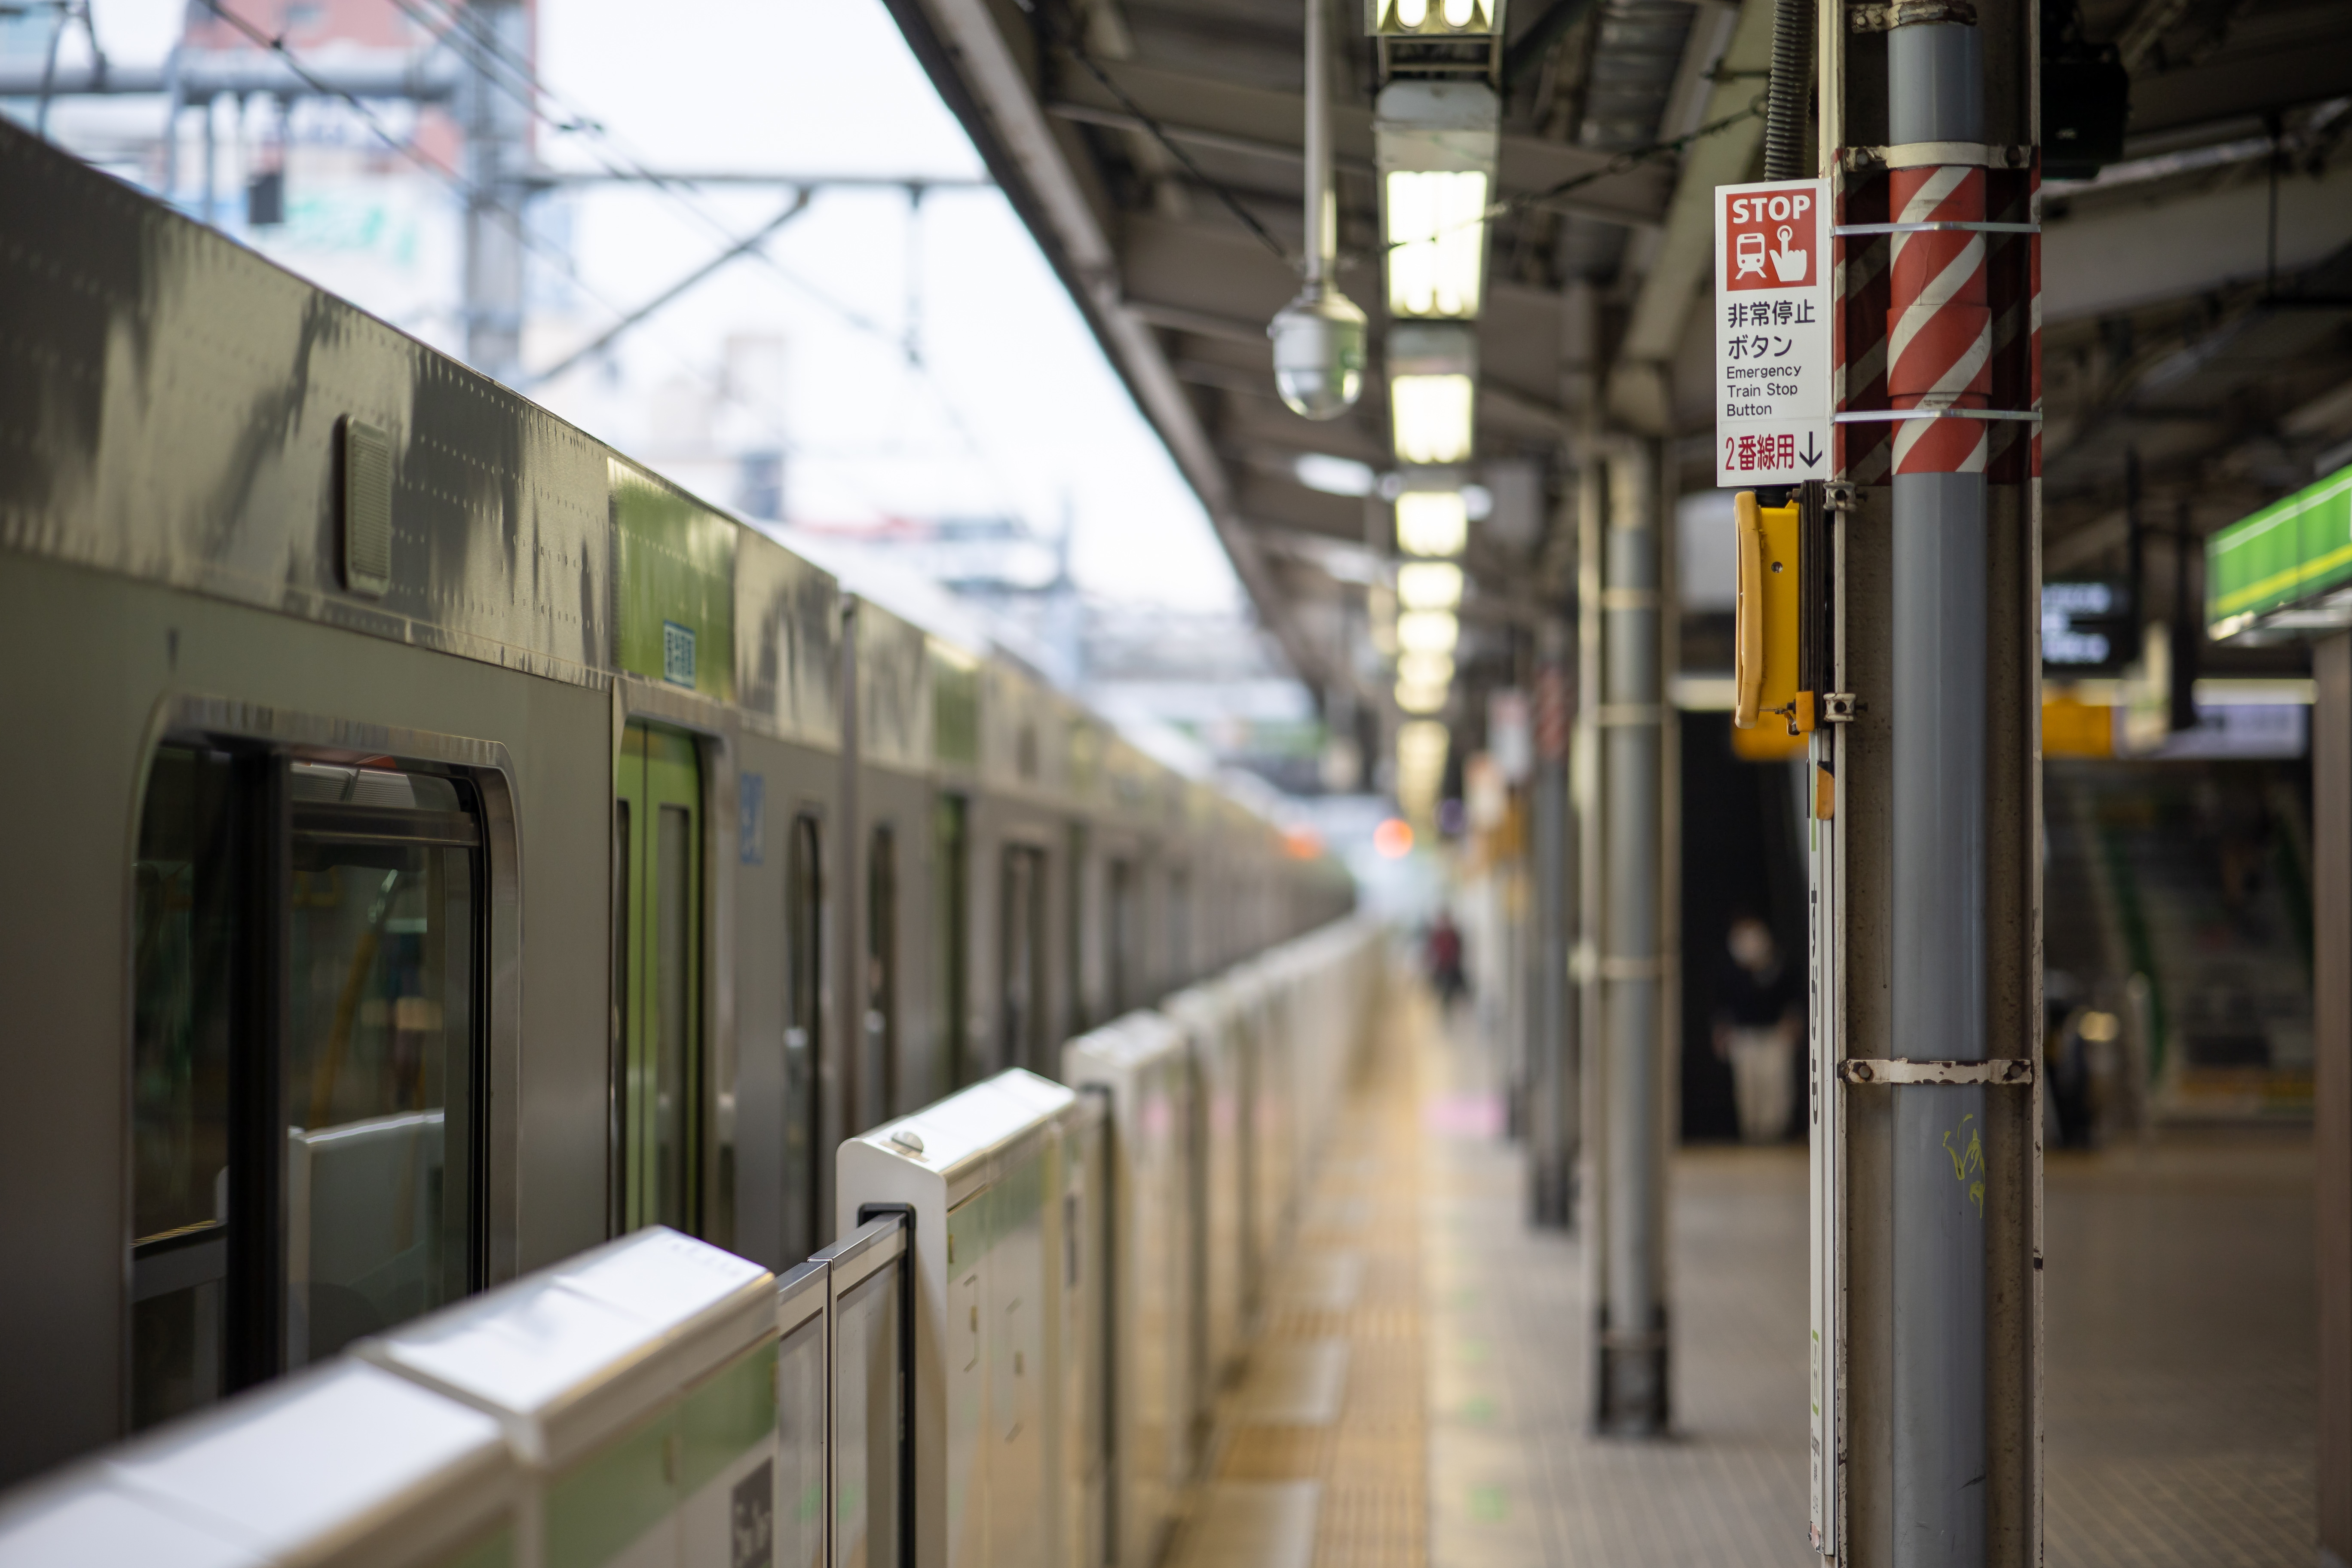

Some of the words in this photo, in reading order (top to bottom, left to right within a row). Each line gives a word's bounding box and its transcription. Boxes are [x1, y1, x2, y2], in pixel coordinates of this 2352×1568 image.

[1732, 195, 1810, 224] STOP
[1728, 299, 1816, 328] 非常停止
[1728, 334, 1792, 359] ボタン
[1727, 366, 1801, 379] Emergency
[1727, 384, 1761, 398] Train
[1767, 383, 1798, 396] Stop
[1727, 404, 1772, 416] Button
[1725, 433, 1794, 471] 2番線用
